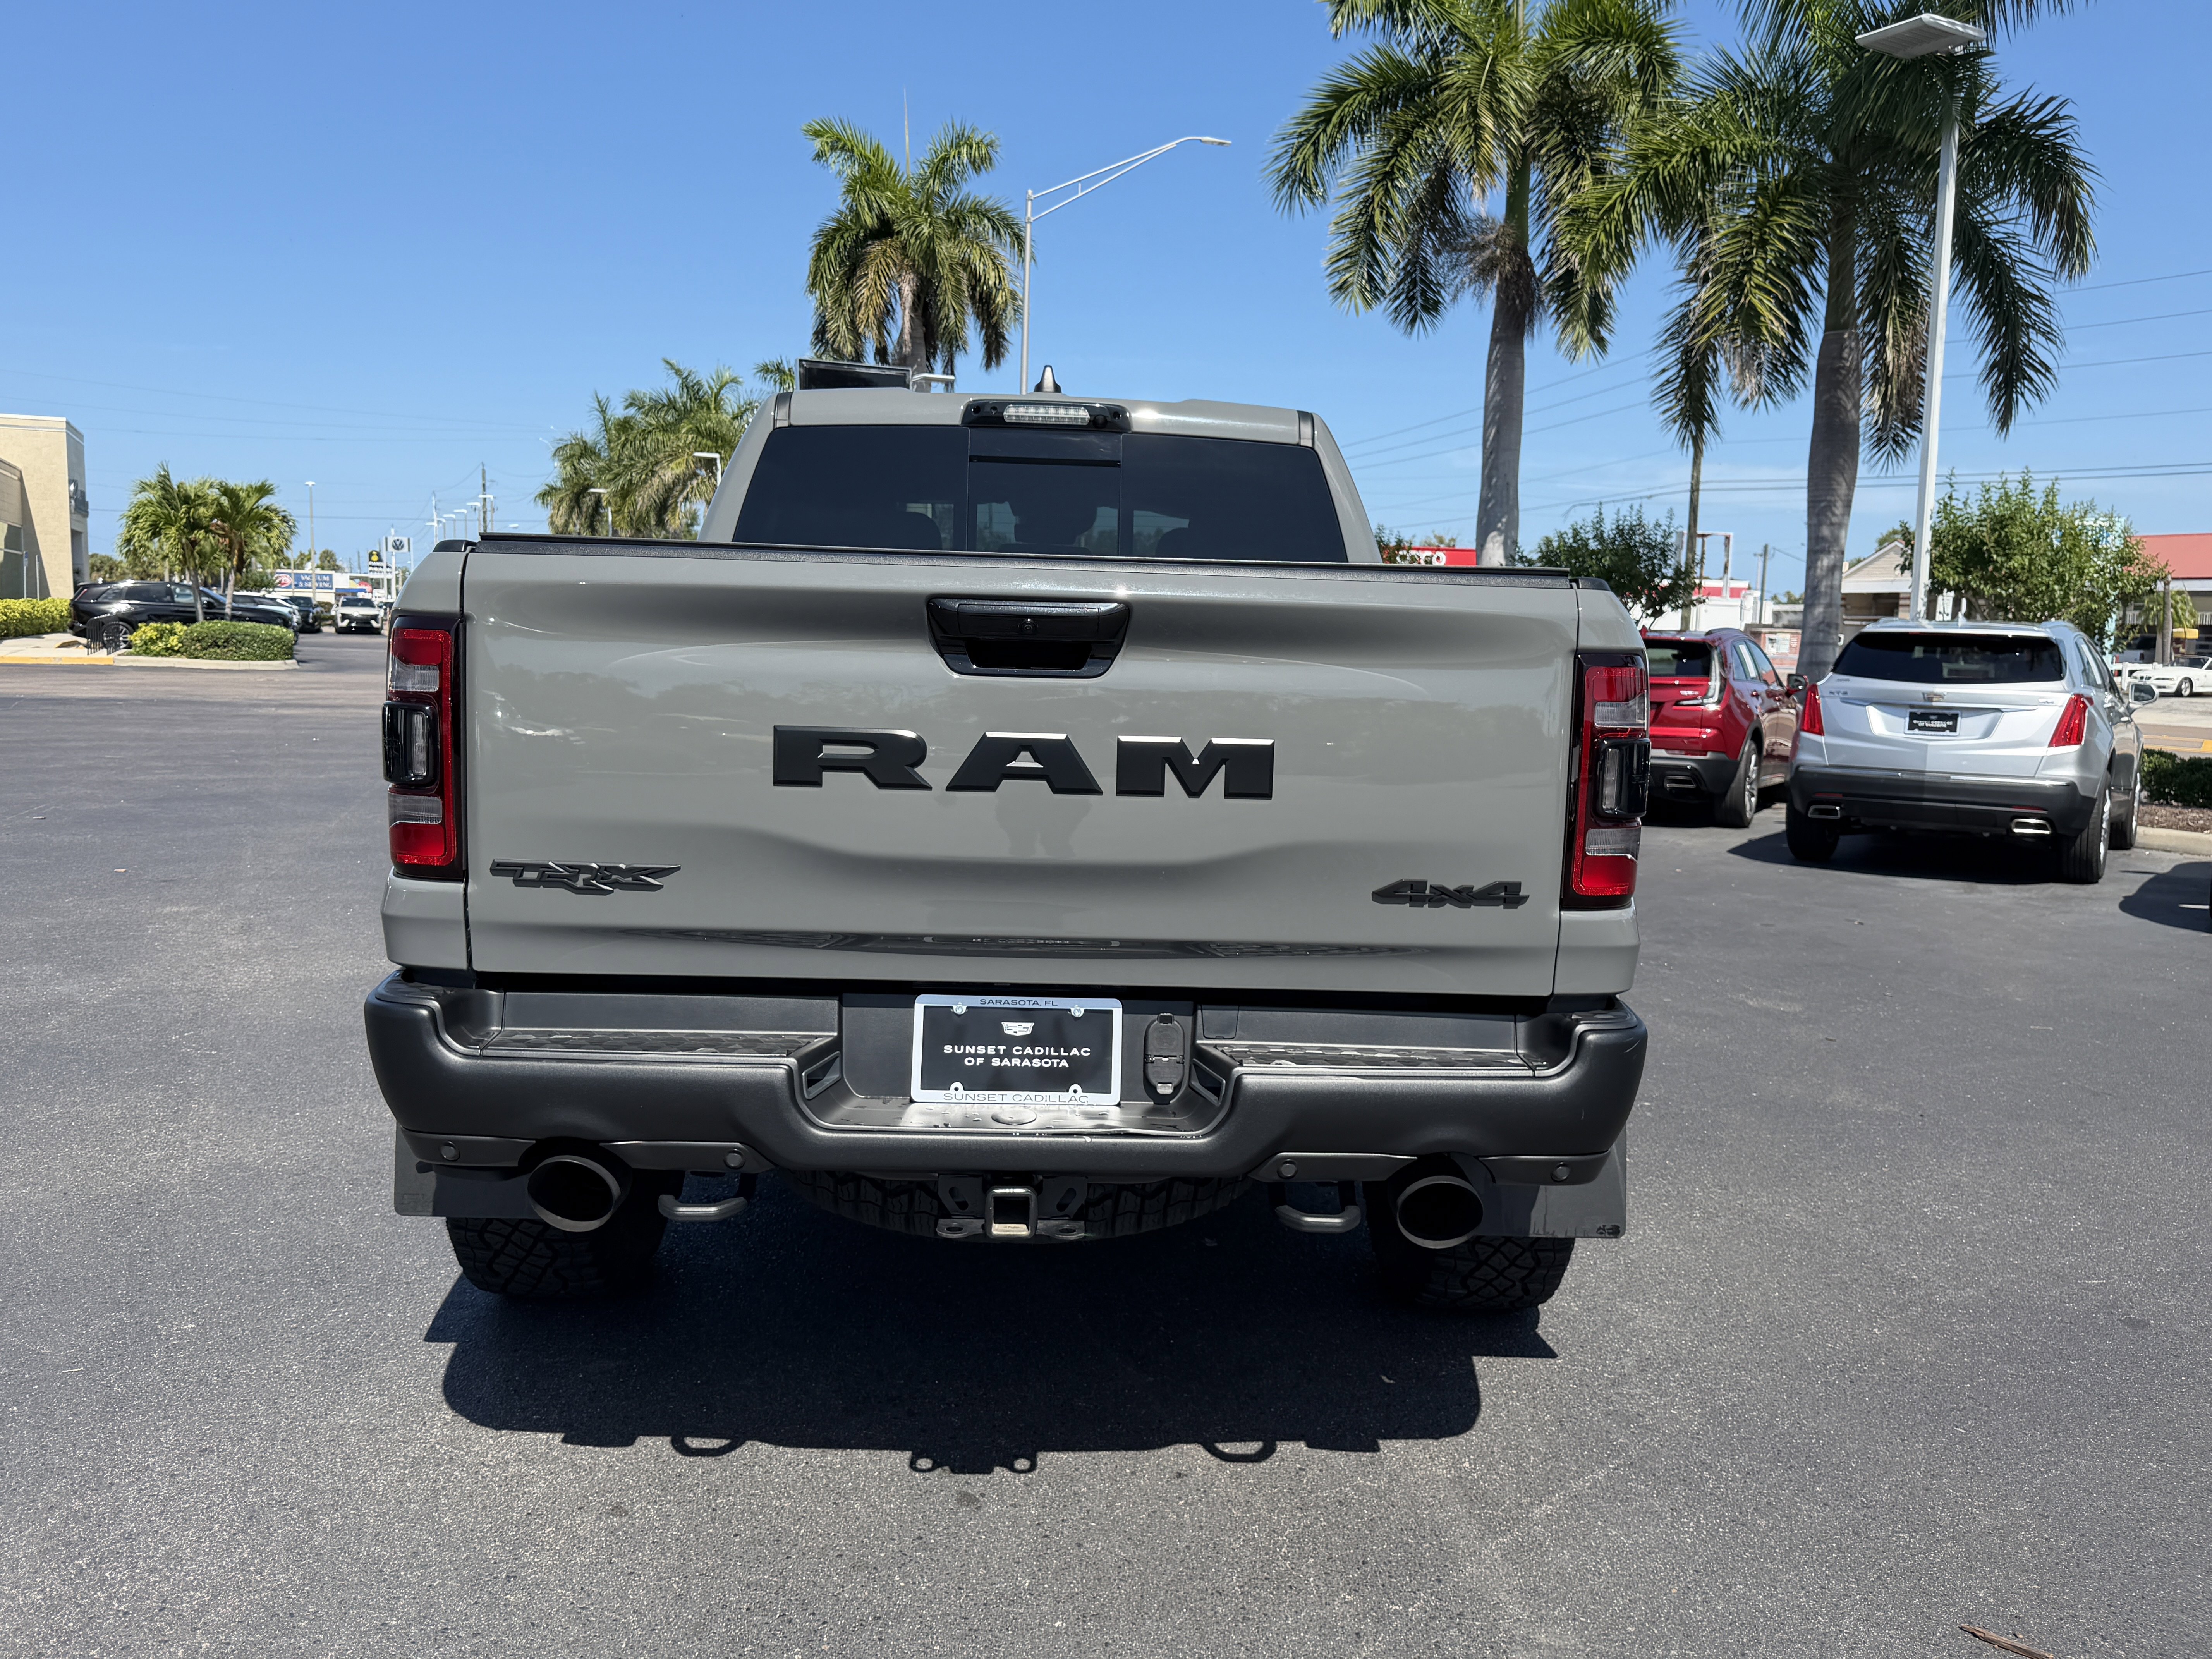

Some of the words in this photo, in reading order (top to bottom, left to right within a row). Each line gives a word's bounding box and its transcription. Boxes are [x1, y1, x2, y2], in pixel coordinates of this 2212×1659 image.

[773, 725, 1275, 799] RAM
[489, 858, 681, 896] TRX
[980, 998, 1042, 1006] SARASOTA,
[943, 1044, 1006, 1054] SUNSET
[1012, 1046, 1091, 1056] CADILLAC
[964, 1057, 985, 1066] OF
[991, 1057, 1069, 1068] SARASOTA
[943, 1093, 1008, 1101] SUNSET
[1012, 1094, 1089, 1103] CADILLAC
